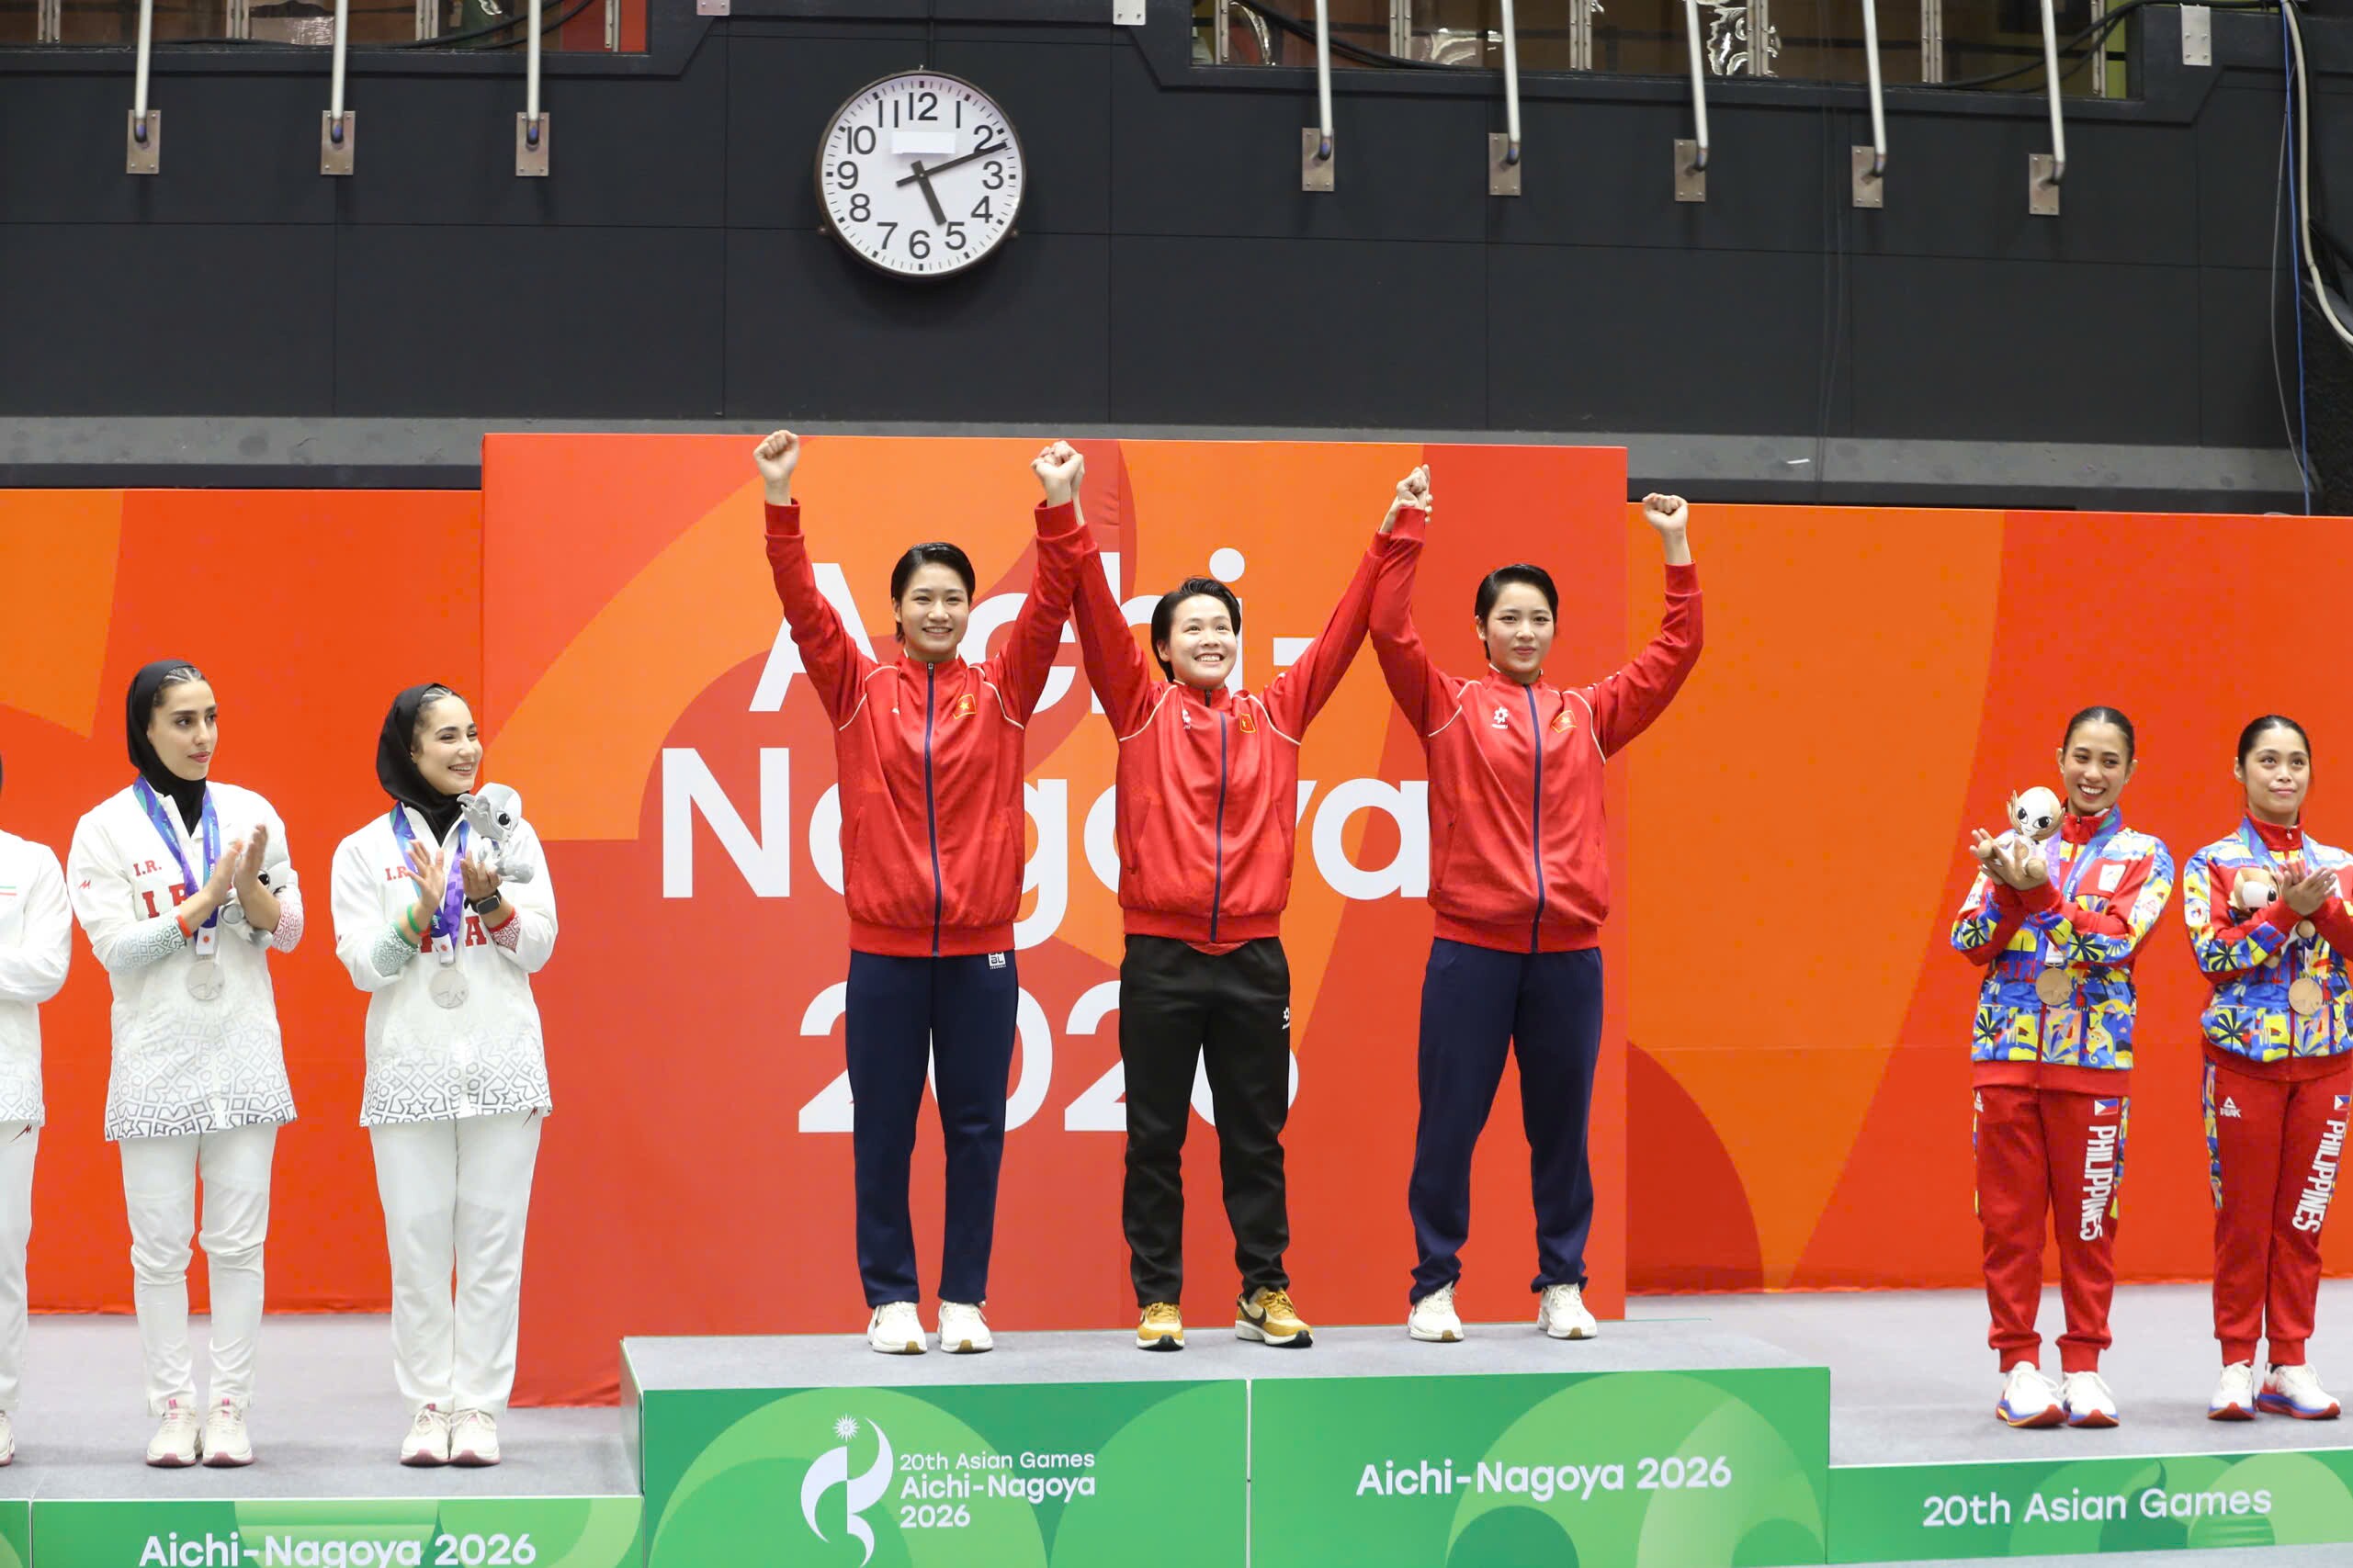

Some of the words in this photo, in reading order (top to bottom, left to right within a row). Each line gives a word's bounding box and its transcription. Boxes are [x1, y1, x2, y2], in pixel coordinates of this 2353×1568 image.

[878, 100, 899, 128] 11
[909, 92, 938, 121] 12
[956, 101, 961, 129] 1
[847, 126, 877, 155] 10
[973, 125, 994, 154] 2
[837, 161, 859, 190] 9
[982, 161, 1004, 189] 3
[849, 193, 871, 222] 8
[970, 196, 993, 223] 4
[877, 222, 899, 250] 7
[909, 231, 931, 259] 6
[945, 221, 966, 250] 5
[2080, 1125, 2117, 1241] PHILIPPINES
[2292, 1120, 2347, 1233] PHILIPPINES
[899, 1452, 948, 1472] 20th
[955, 1450, 1012, 1470] Asian
[1019, 1450, 1095, 1469] Games
[899, 1472, 1096, 1504] Aichi-Nagoya
[1355, 1459, 1624, 1502] Aichi-Nagoya
[1636, 1456, 1733, 1489] 2026
[899, 1504, 971, 1529] 2026
[1922, 1492, 2011, 1527] 20th
[2023, 1488, 2128, 1523] Asian
[2139, 1488, 2272, 1518] Games
[139, 1531, 421, 1568] Aichi-Nagoya
[434, 1533, 537, 1566] 2026
